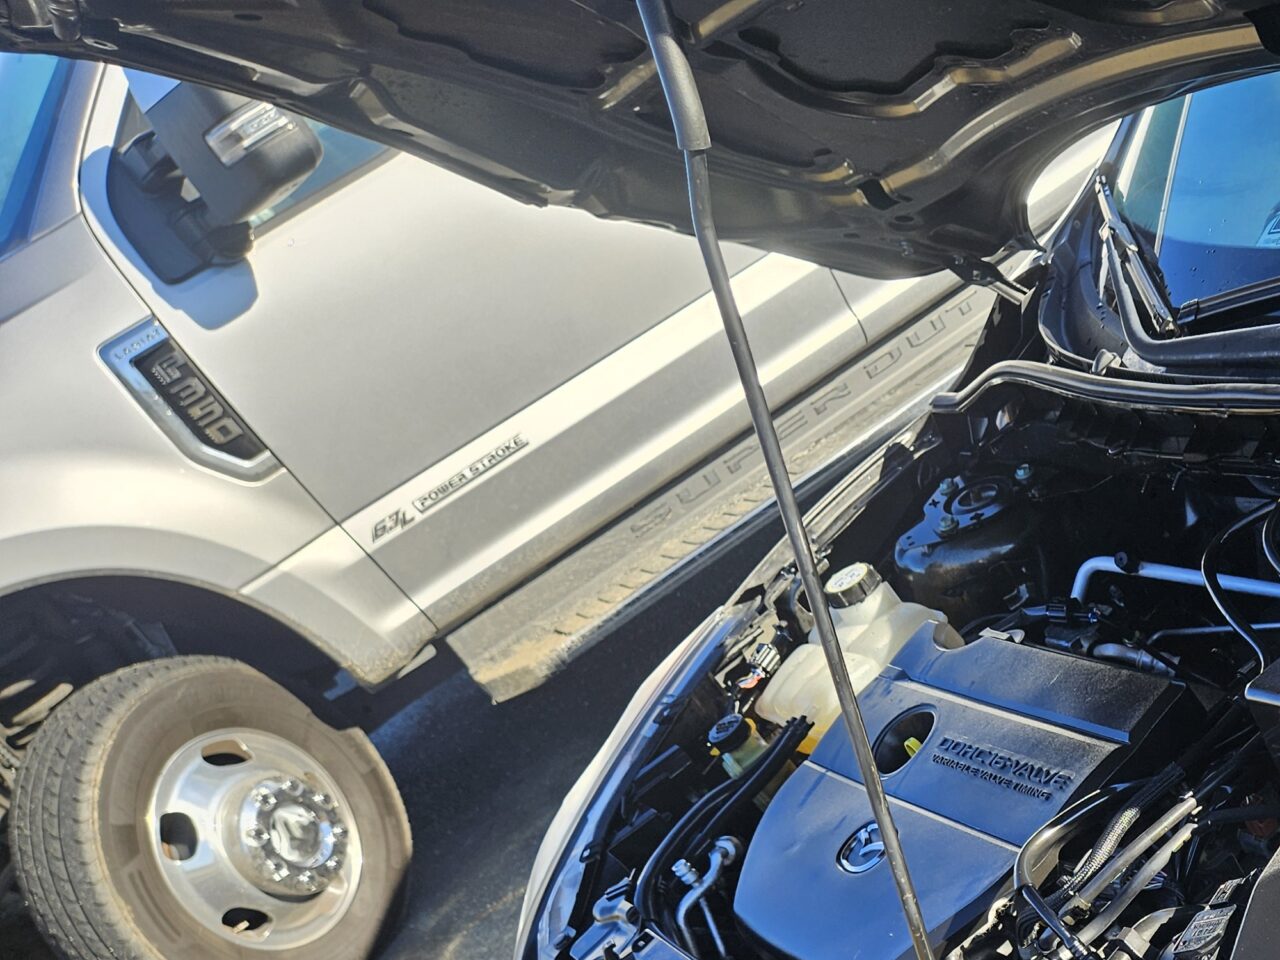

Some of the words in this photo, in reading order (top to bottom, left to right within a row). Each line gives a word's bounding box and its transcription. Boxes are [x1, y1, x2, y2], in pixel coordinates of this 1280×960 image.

[862, 288, 980, 379] DUT
[419, 472, 467, 508] POWER
[469, 433, 526, 476] STROKE
[932, 753, 980, 776] VARIABLE
[979, 768, 1013, 789] VALVE
[1012, 781, 1053, 801] TIMING
[937, 736, 993, 765] DOHC
